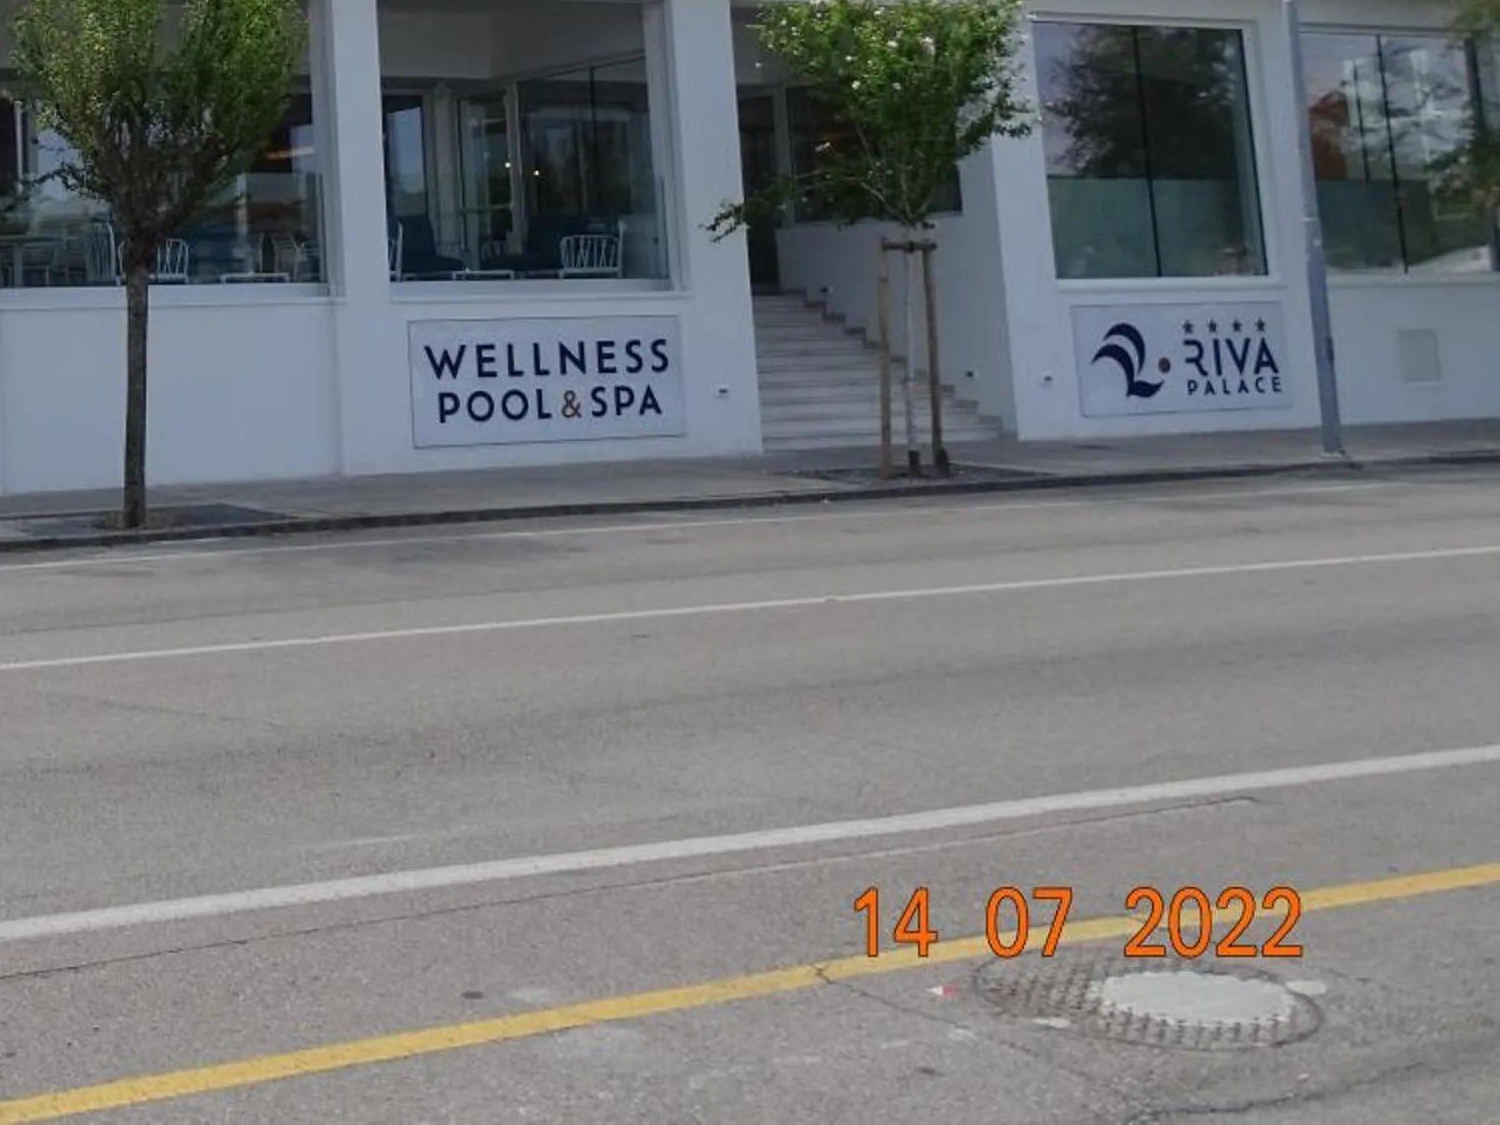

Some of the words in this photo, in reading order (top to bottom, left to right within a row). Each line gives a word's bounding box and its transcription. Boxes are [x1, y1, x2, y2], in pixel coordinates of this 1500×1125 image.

[424, 338, 670, 380] WELLNESS
[1182, 337, 1280, 377] RIVA
[1187, 376, 1283, 396] PALACE
